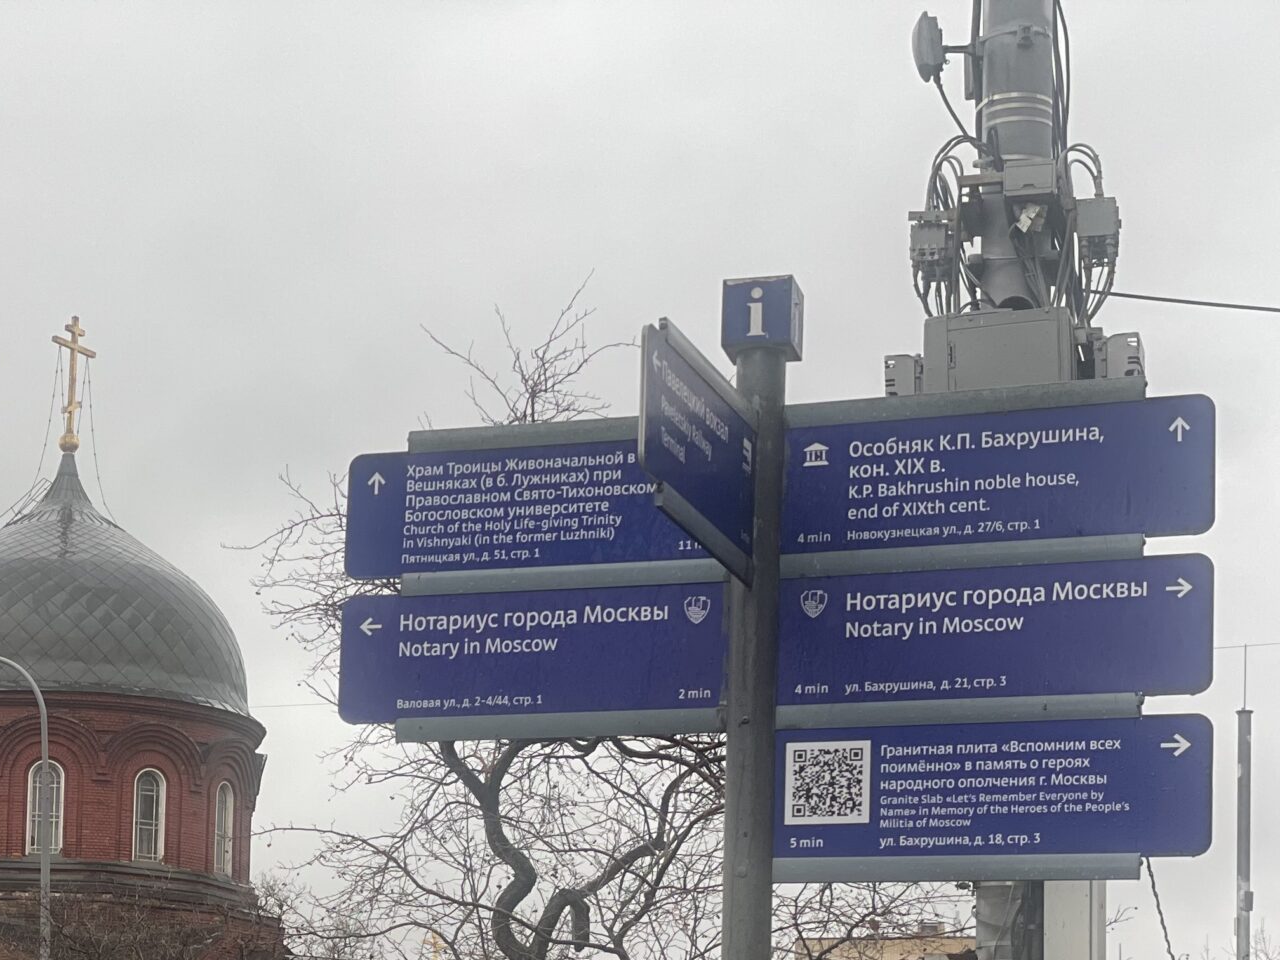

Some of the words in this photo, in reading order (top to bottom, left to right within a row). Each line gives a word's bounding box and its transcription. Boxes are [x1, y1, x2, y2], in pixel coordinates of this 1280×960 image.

[746, 287, 766, 336] i
[705, 408, 729, 444] вокзал
[661, 426, 686, 465] Terminal
[849, 436, 934, 457] Особняк
[406, 464, 443, 479] Храм
[446, 461, 501, 476] Троицы
[504, 450, 623, 471] Живоначальной
[627, 452, 635, 463] в
[406, 475, 477, 492] Вешняках
[480, 474, 493, 490] (в
[511, 468, 590, 488] Лужниках)
[593, 469, 621, 484] при
[878, 477, 970, 497] Bakhrushin
[974, 473, 1021, 491] noble
[405, 489, 511, 509] Православном
[514, 483, 657, 501] Свято-Тихоновском
[404, 506, 504, 523] Богословском
[507, 500, 609, 519] университете
[847, 503, 878, 520] end
[881, 501, 900, 517] of
[902, 499, 945, 516] XIXth
[403, 522, 444, 535] Church
[447, 521, 460, 533] of
[461, 520, 482, 532] the
[484, 516, 512, 532] Holy
[514, 514, 579, 531] Life-giving
[581, 513, 622, 527] Trinity
[847, 526, 940, 541] Новокузнецкая
[1033, 518, 1040, 529] 1
[402, 537, 414, 548] in
[416, 534, 472, 549] Vishnyaki
[474, 533, 490, 547] (in
[492, 531, 513, 544] the
[515, 529, 558, 543] former
[560, 526, 615, 541] Luzhniki)
[678, 539, 692, 550] 11
[797, 533, 804, 543] 4
[807, 531, 831, 543] min
[401, 553, 460, 564] Пятницкая
[534, 547, 539, 558] 1
[846, 590, 957, 613] Нотариус
[963, 586, 1045, 609] города
[1052, 581, 1147, 601] Москвы
[399, 613, 498, 633] Нотариус
[504, 609, 577, 630] города
[583, 605, 668, 623] Москвы
[845, 620, 914, 640] Notary
[918, 617, 937, 635] in
[942, 616, 1024, 633] Moscow
[398, 640, 460, 659] Notary
[464, 637, 480, 654] in
[484, 637, 558, 654] Moscow
[794, 684, 802, 694] 4
[804, 683, 828, 694] min
[999, 675, 1006, 686] 3
[396, 698, 441, 709] Валовая
[536, 694, 542, 704] 1
[678, 688, 685, 699] 2
[687, 687, 711, 698] min
[880, 744, 953, 759] Гранитная
[956, 743, 998, 754] плита
[1089, 739, 1121, 750] всех
[964, 761, 972, 771] в
[975, 759, 1027, 770] память
[1029, 758, 1039, 769] о
[1042, 757, 1090, 771] героях
[880, 778, 955, 793] народного
[957, 776, 1036, 788] ополчения
[1050, 773, 1107, 785] Москвы
[880, 794, 919, 805] Granite
[921, 793, 943, 804] Slab
[978, 791, 1037, 802] Remember
[1039, 791, 1088, 804] Everyone
[1090, 789, 1104, 802] by
[918, 806, 929, 815] in
[931, 806, 975, 817] Memory
[976, 804, 989, 814] of
[989, 804, 1008, 814] the
[1010, 804, 1048, 813] Heroes
[1050, 802, 1062, 813] of
[1063, 802, 1083, 812] the
[879, 818, 914, 828] Militia
[915, 817, 927, 828] of
[928, 818, 971, 827] Moscow
[790, 837, 797, 848] 5
[799, 836, 823, 847] min
[1033, 832, 1040, 844] 3
